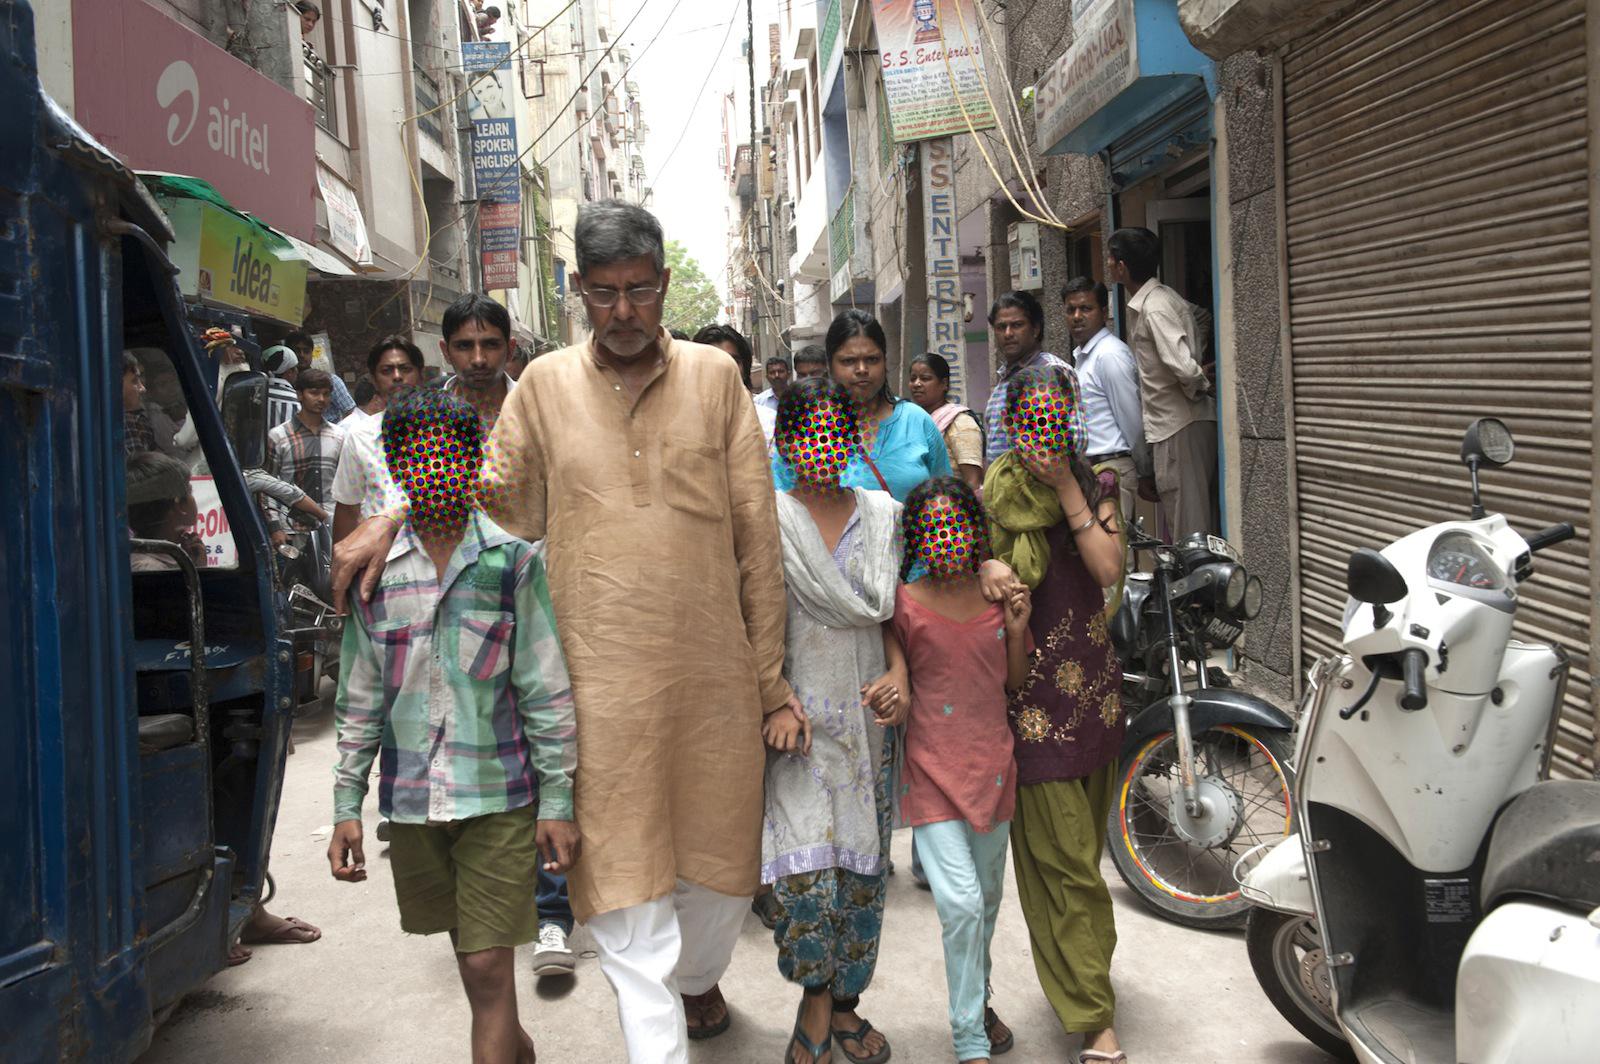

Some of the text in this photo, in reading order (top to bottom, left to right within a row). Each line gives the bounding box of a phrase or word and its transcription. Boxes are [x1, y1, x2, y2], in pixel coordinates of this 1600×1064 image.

[916, 45, 981, 65] Entepriss
[207, 98, 270, 175] airtel
[476, 122, 509, 137] LEARN
[474, 138, 514, 154] SPOKEN
[475, 154, 517, 169] ENGLISH
[484, 262, 516, 274] INSTITUTE
